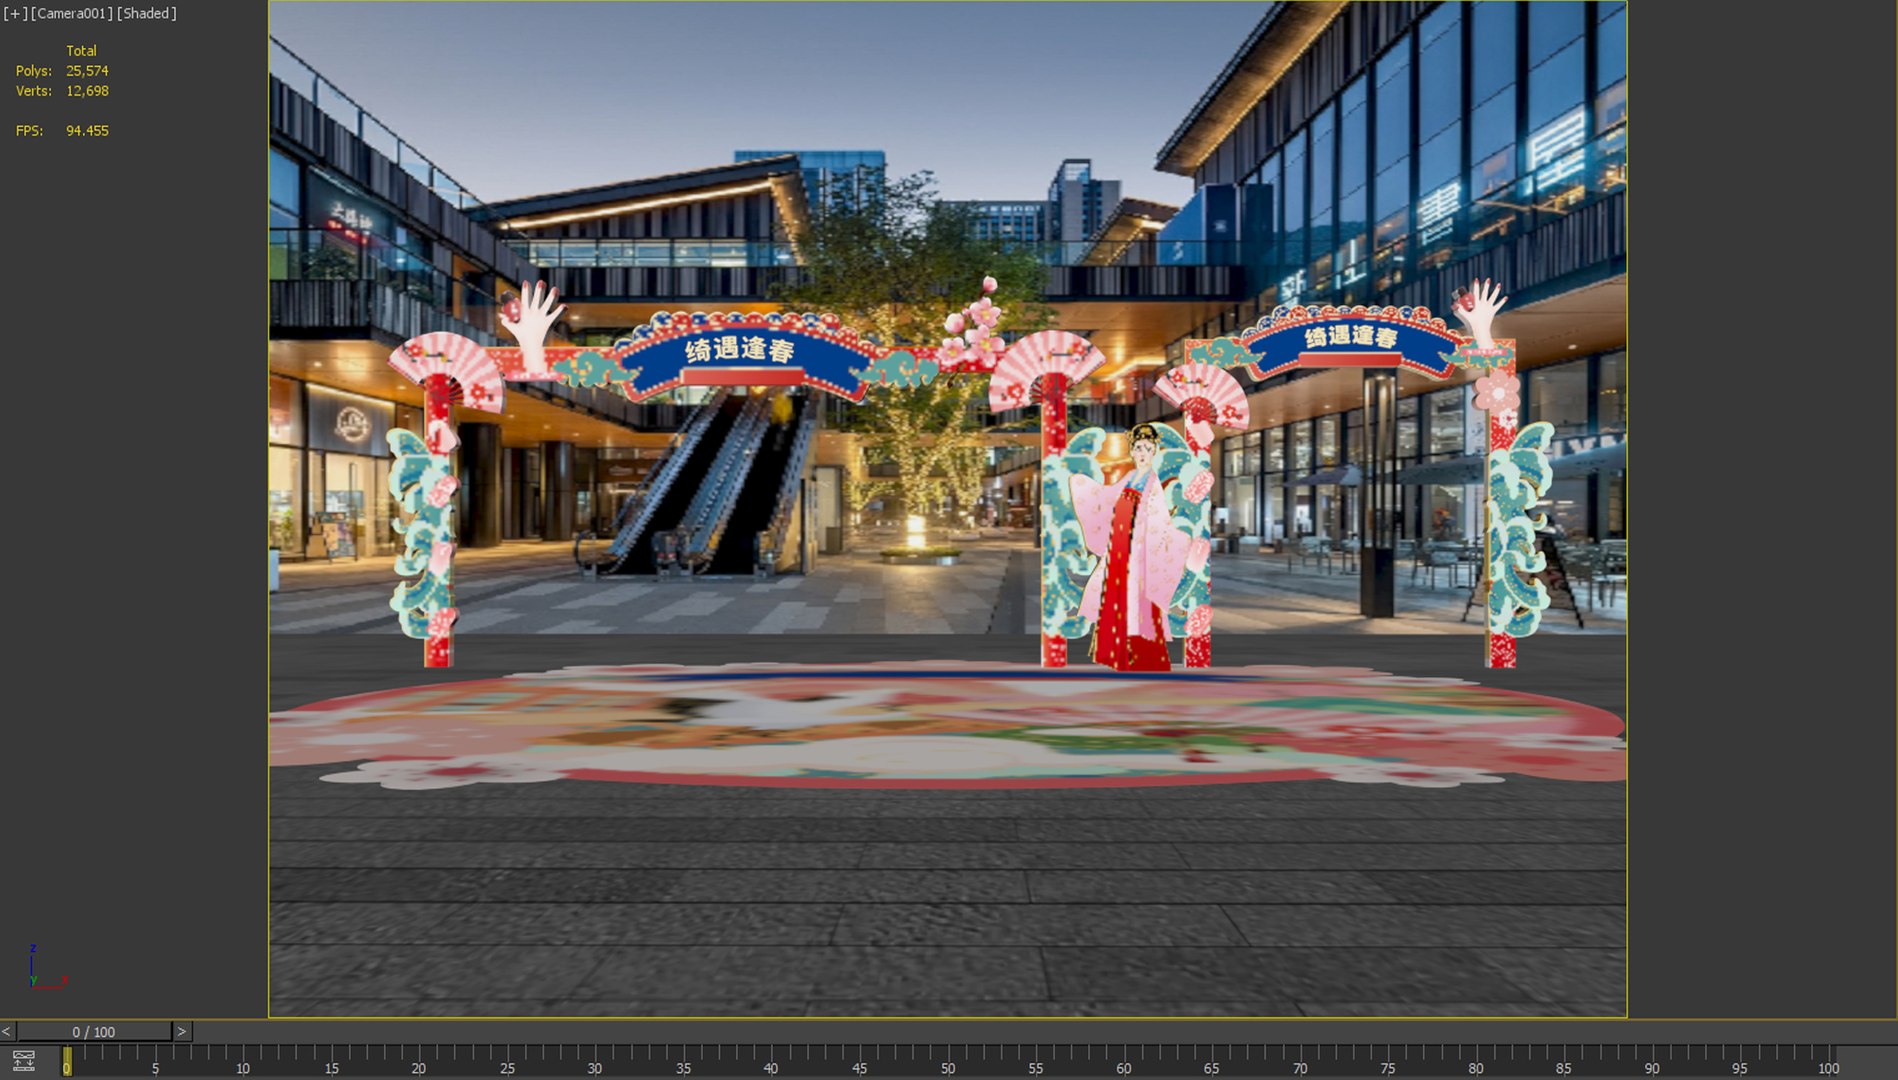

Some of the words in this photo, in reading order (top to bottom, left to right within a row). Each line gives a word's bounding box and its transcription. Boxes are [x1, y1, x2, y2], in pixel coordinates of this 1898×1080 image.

[31, 6, 113, 22] [Camera001]
[117, 6, 177, 22] [Shaded]
[66, 44, 97, 57] Total
[15, 64, 52, 79] Polys:
[66, 64, 109, 79] 25,574
[15, 85, 52, 97] Verts:
[66, 85, 109, 98] 12,698
[15, 124, 43, 137] FPS:
[66, 124, 109, 137] 94.455
[685, 335, 795, 364] 绮遇逢春
[94, 1026, 116, 1038] 100
[62, 1062, 71, 1075] 0
[152, 1062, 160, 1075] 5
[236, 1062, 251, 1075] 10
[325, 1062, 340, 1075] 15
[411, 1062, 427, 1075] 20
[500, 1062, 516, 1075] 25
[587, 1062, 603, 1075] 30
[676, 1062, 692, 1075] 35
[763, 1062, 779, 1075] 40
[851, 1062, 868, 1075] 45
[941, 1062, 956, 1075] 50
[1028, 1062, 1044, 1075] 55
[1116, 1062, 1132, 1075] 60
[1203, 1062, 1220, 1075] 65
[1293, 1062, 1308, 1075] 70
[1380, 1062, 1396, 1075] 75
[1468, 1062, 1484, 1075] 80
[1555, 1062, 1572, 1075] 85
[1644, 1062, 1660, 1075] 90
[1731, 1062, 1748, 1075] 95
[1818, 1062, 1841, 1075] 100
